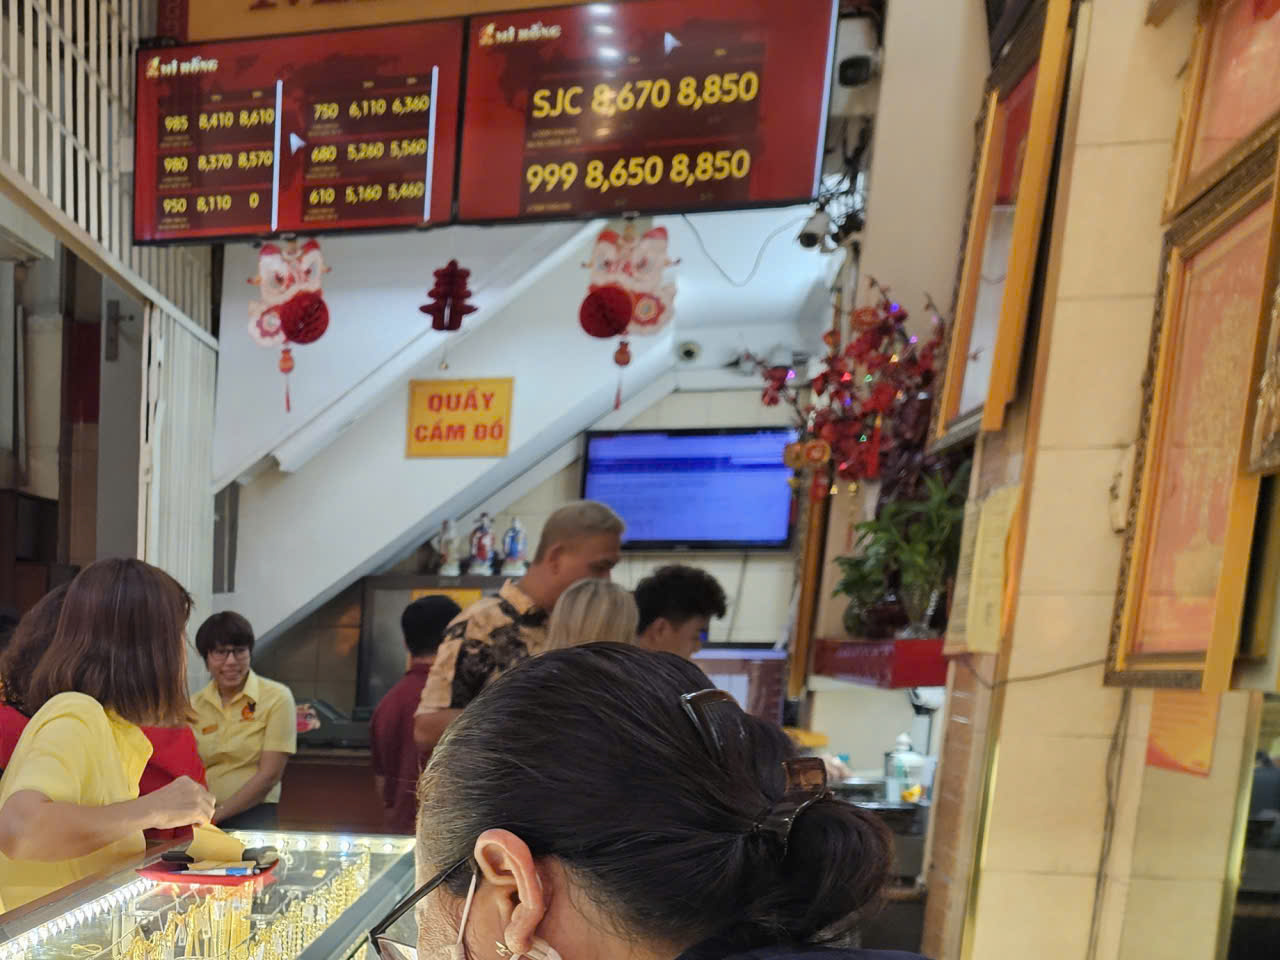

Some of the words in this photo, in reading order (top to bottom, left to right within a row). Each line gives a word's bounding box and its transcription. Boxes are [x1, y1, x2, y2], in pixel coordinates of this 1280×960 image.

[532, 86, 584, 118] SJC
[592, 79, 671, 117] 8,670
[677, 72, 759, 110] 8,850
[313, 103, 339, 120] 750
[348, 99, 387, 119] 6,110
[391, 94, 429, 115] 6,360
[164, 115, 188, 131] 985
[199, 112, 234, 131] 8,410
[239, 108, 274, 128] 8,610
[164, 157, 188, 173] 980
[198, 154, 233, 172] 8,370
[238, 151, 273, 170] 8,570
[311, 145, 336, 163] 680
[347, 142, 384, 161] 5,260
[526, 162, 578, 192] 999
[585, 155, 663, 192] 8,650
[669, 149, 751, 187] 8,850
[163, 198, 187, 214] 950
[196, 195, 231, 213] 8,110
[248, 192, 259, 208] 0
[309, 188, 335, 205] 610
[345, 184, 382, 205] 5,160
